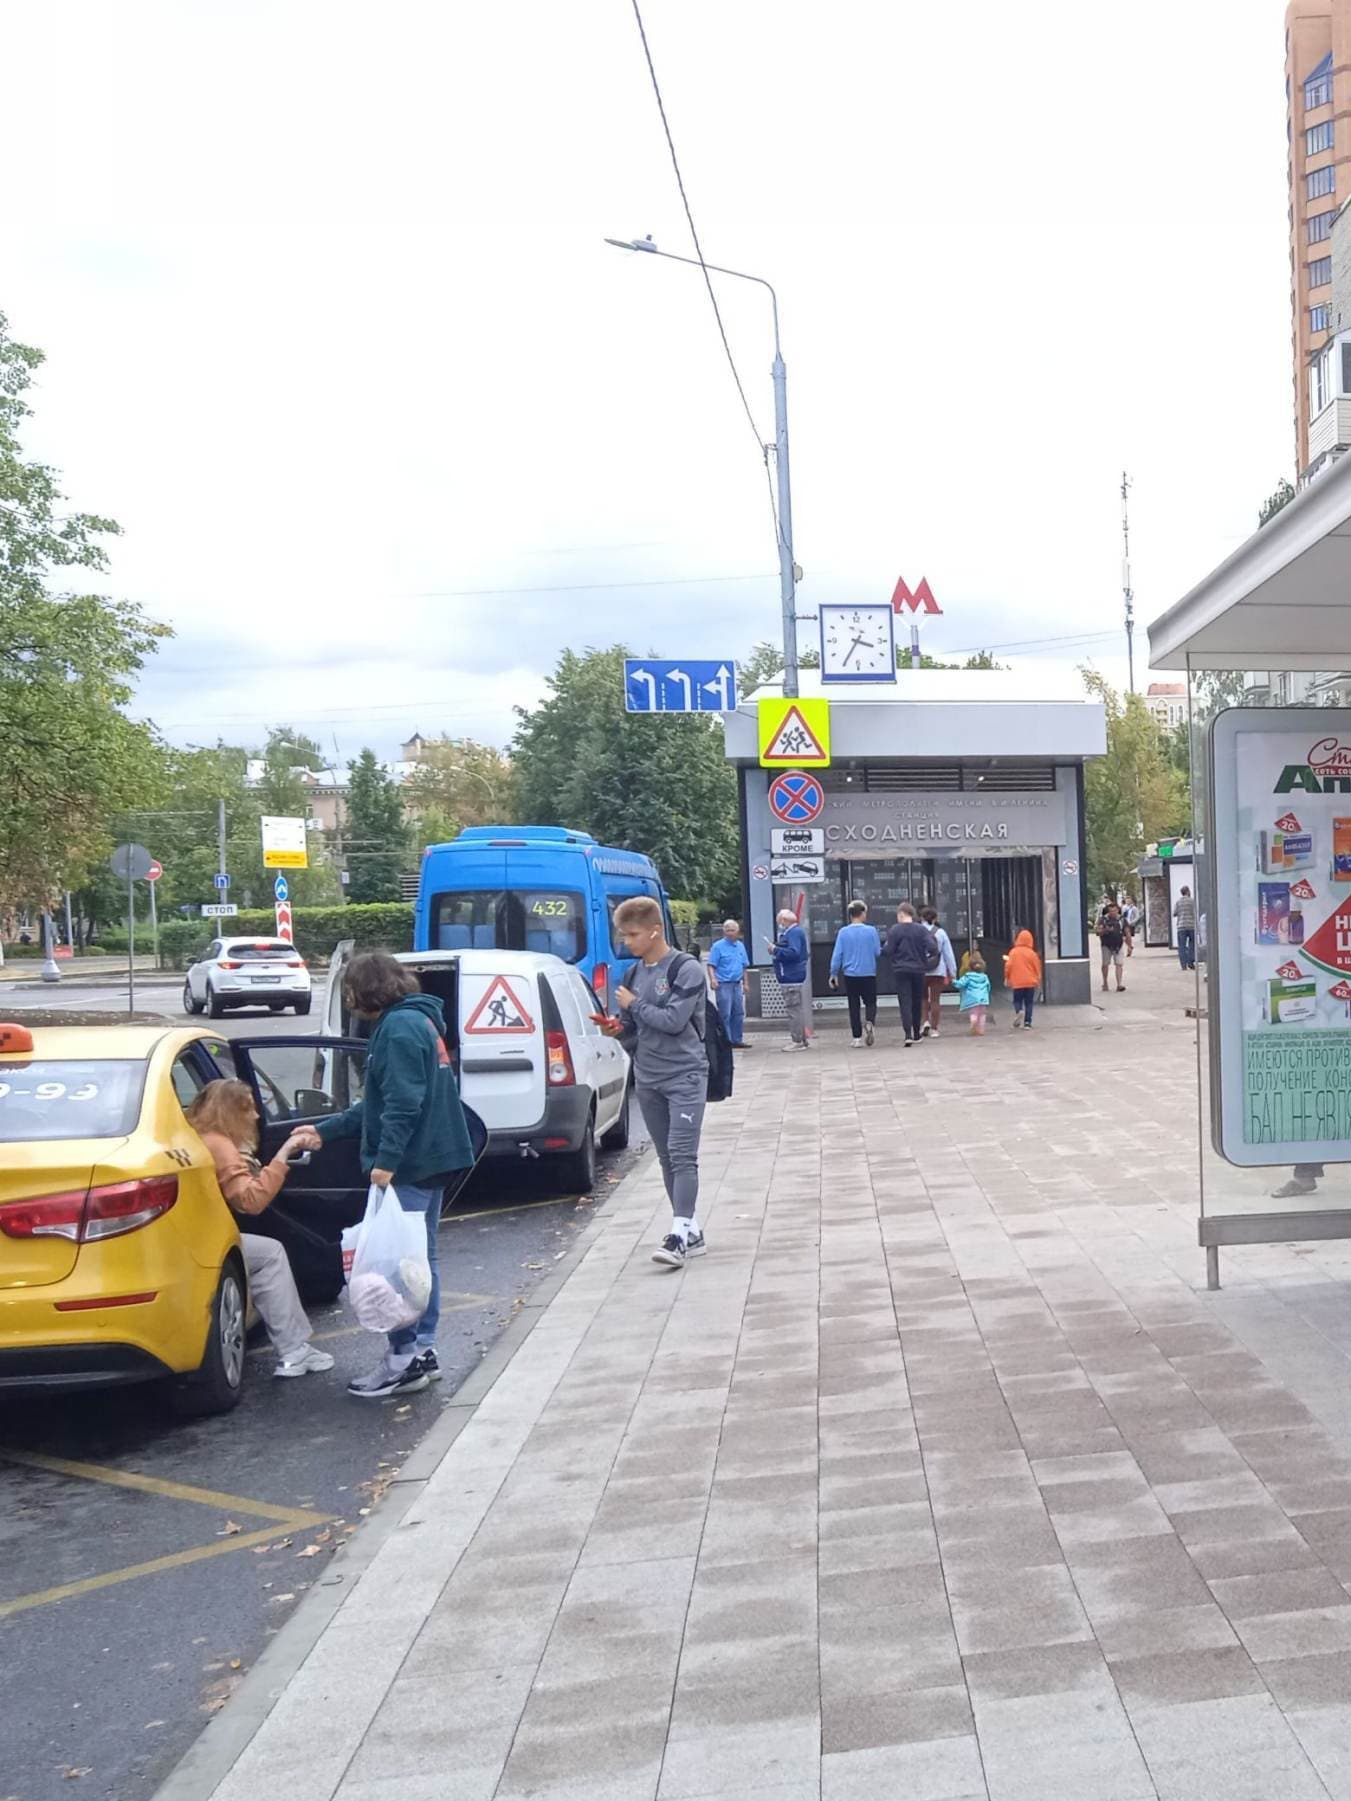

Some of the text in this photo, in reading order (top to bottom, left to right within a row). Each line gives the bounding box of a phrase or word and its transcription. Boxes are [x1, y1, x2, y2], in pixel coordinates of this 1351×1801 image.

[890, 575, 943, 614] М
[826, 823, 1009, 842] СХОДНЕНСКАЯ
[206, 905, 233, 915] СТОП
[531, 900, 568, 917] 432
[1248, 1048, 1303, 1070] ИМЕЮТСЯ
[1248, 1070, 1317, 1090] ПОЛУЧЕНИЕ
